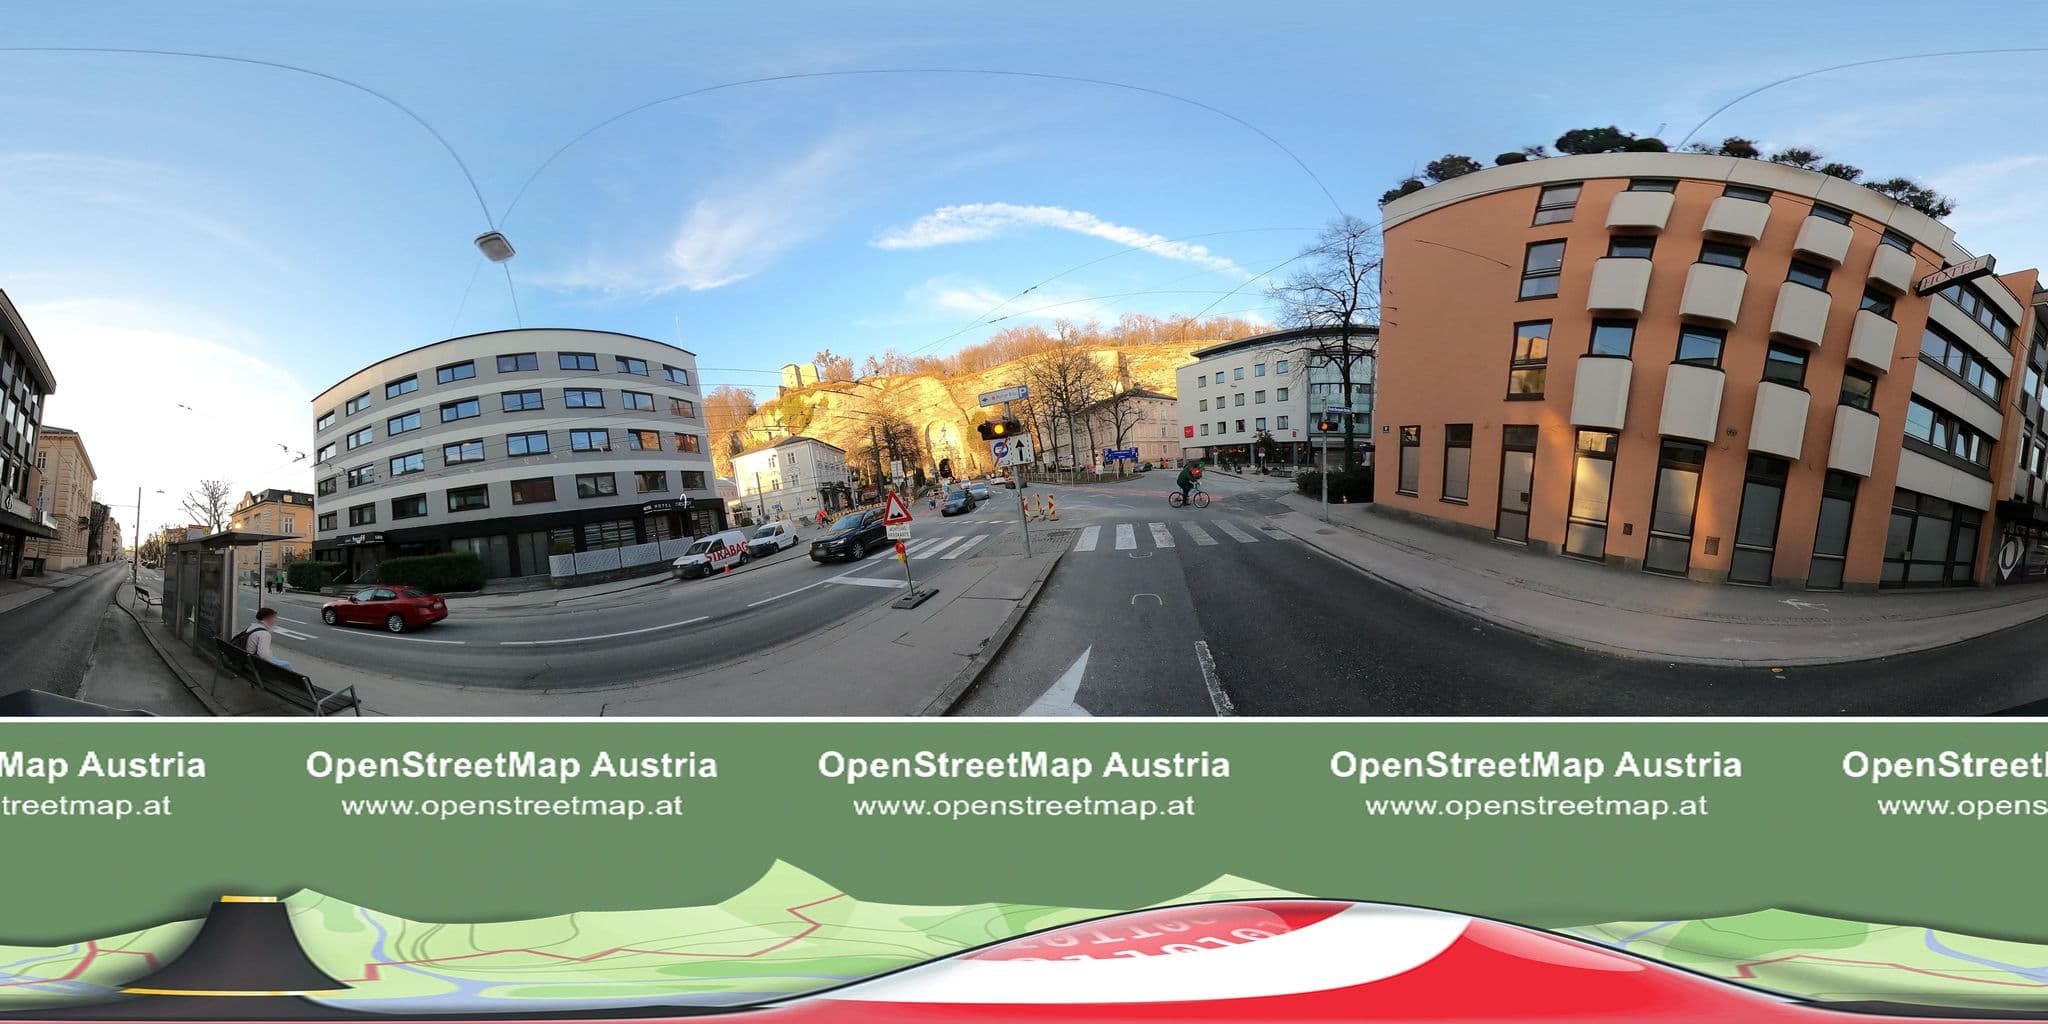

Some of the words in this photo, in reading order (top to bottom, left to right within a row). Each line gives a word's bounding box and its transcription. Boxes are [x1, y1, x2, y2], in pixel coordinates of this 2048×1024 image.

[1923, 260, 1979, 288] HOTEL
[1018, 387, 1027, 398] P
[704, 540, 749, 563] STRABAG
